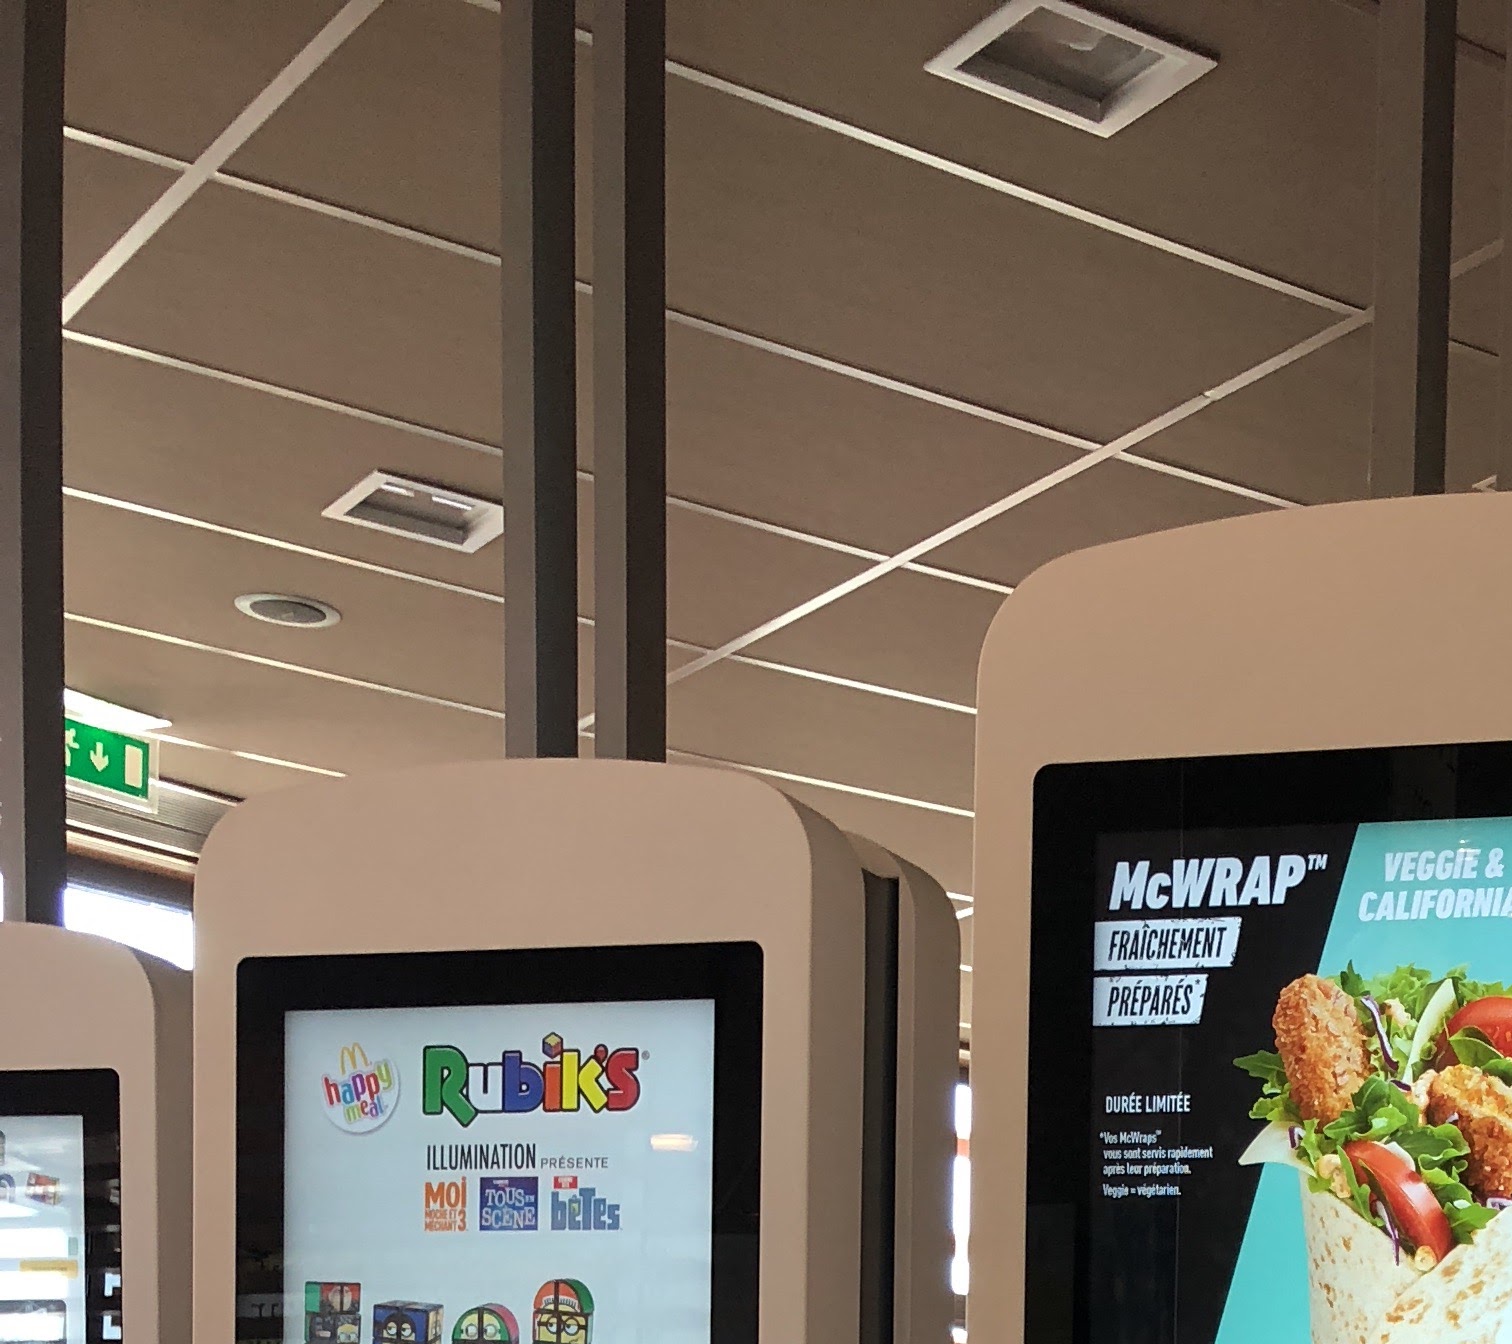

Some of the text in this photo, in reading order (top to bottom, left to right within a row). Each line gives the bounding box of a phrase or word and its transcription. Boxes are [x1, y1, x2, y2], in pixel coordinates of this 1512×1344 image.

[1385, 847, 1505, 882] VEGGIE &
[1108, 923, 1227, 961] FRAÎCHEMENT
[323, 1059, 393, 1106] happy
[345, 1095, 385, 1122] meal
[1105, 1091, 1191, 1113] DURÉE LIMITÉE
[426, 1143, 609, 1170] ILLUMINATION PRÉSENTE
[1103, 1146, 1213, 1161] vous sont servis rapidement
[1103, 1161, 1191, 1177] après leur préparation.
[485, 1187, 524, 1207] TOUS
[1102, 1183, 1129, 1198] Veggie
[1137, 1182, 1181, 1198] végétarien.
[481, 1205, 535, 1229] SCÈNE
